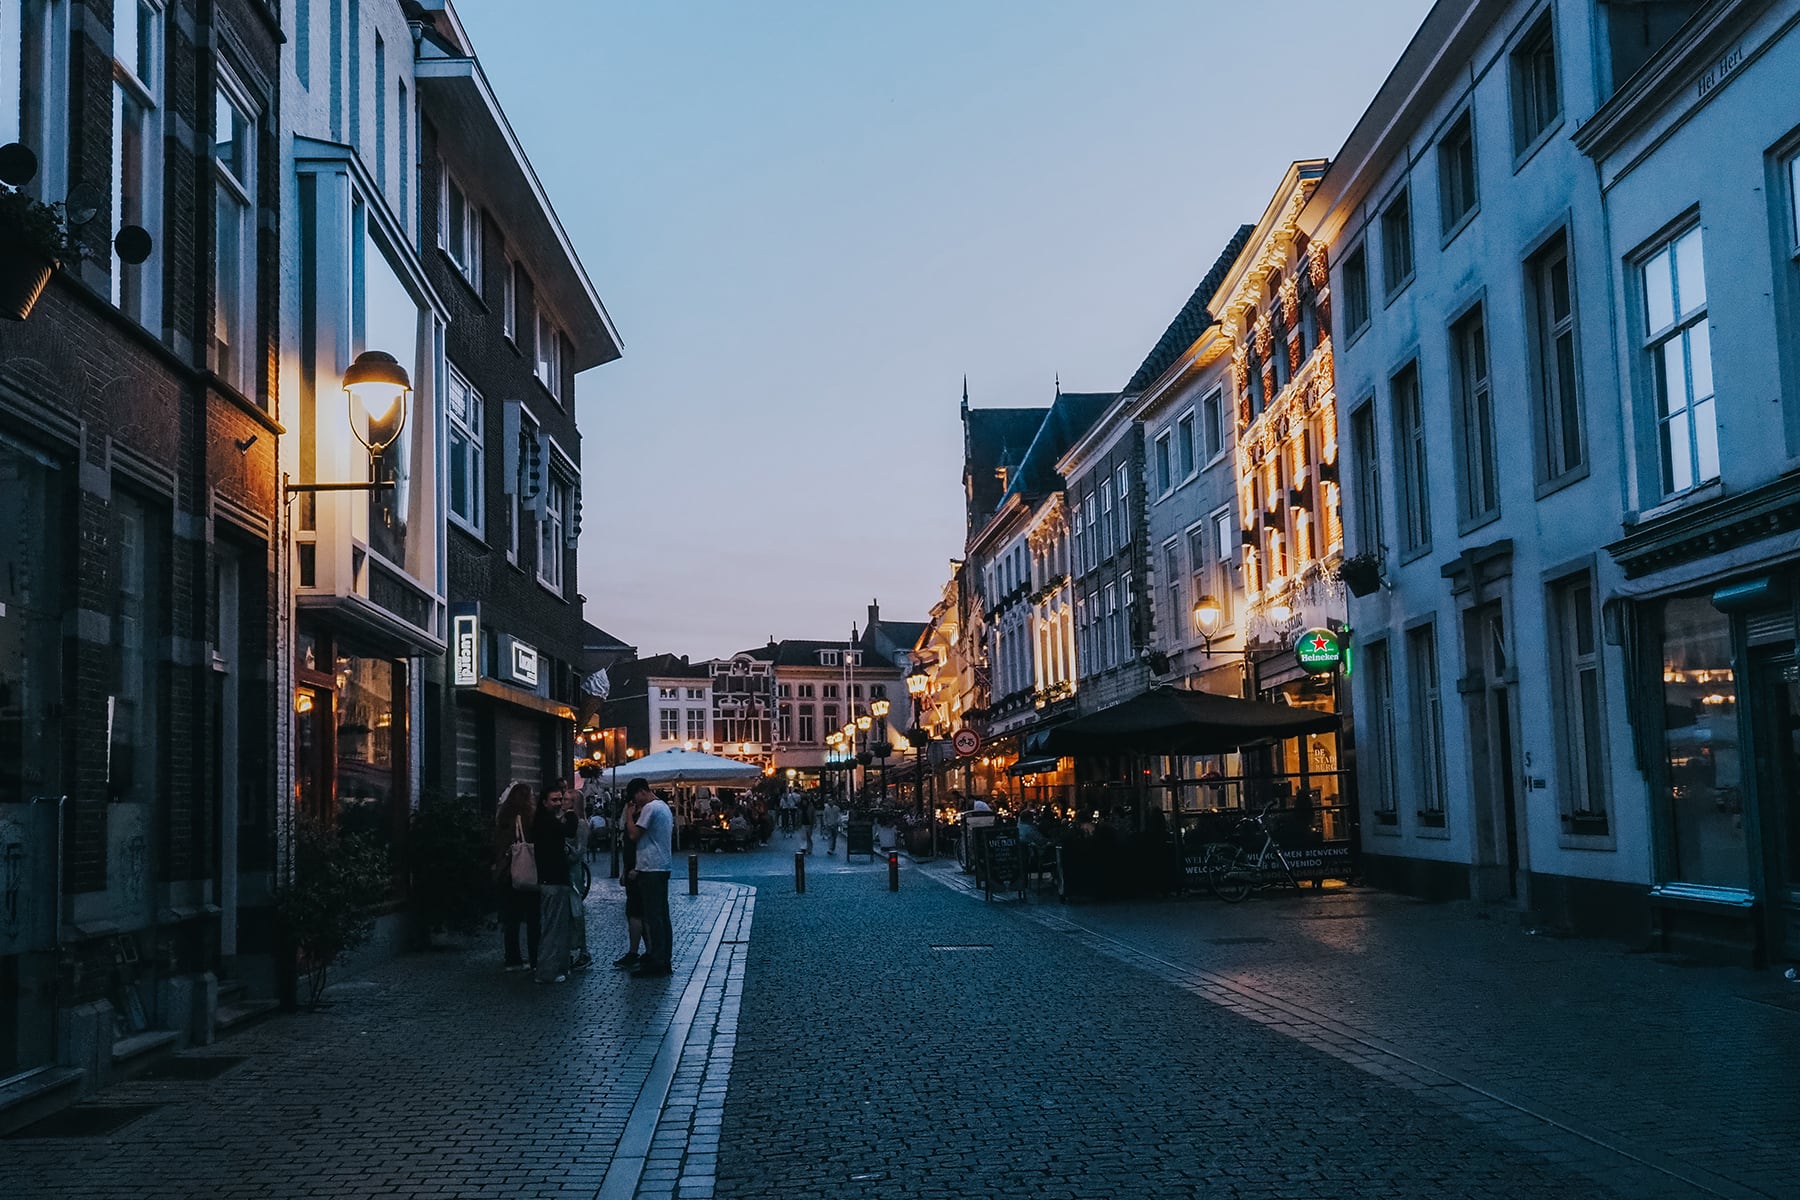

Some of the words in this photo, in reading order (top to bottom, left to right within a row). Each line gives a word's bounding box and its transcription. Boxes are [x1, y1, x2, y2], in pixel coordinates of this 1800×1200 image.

[1698, 71, 1715, 97] Het
[1301, 653, 1339, 662] Heineken
[1271, 858, 1323, 869] BIVENIDO
